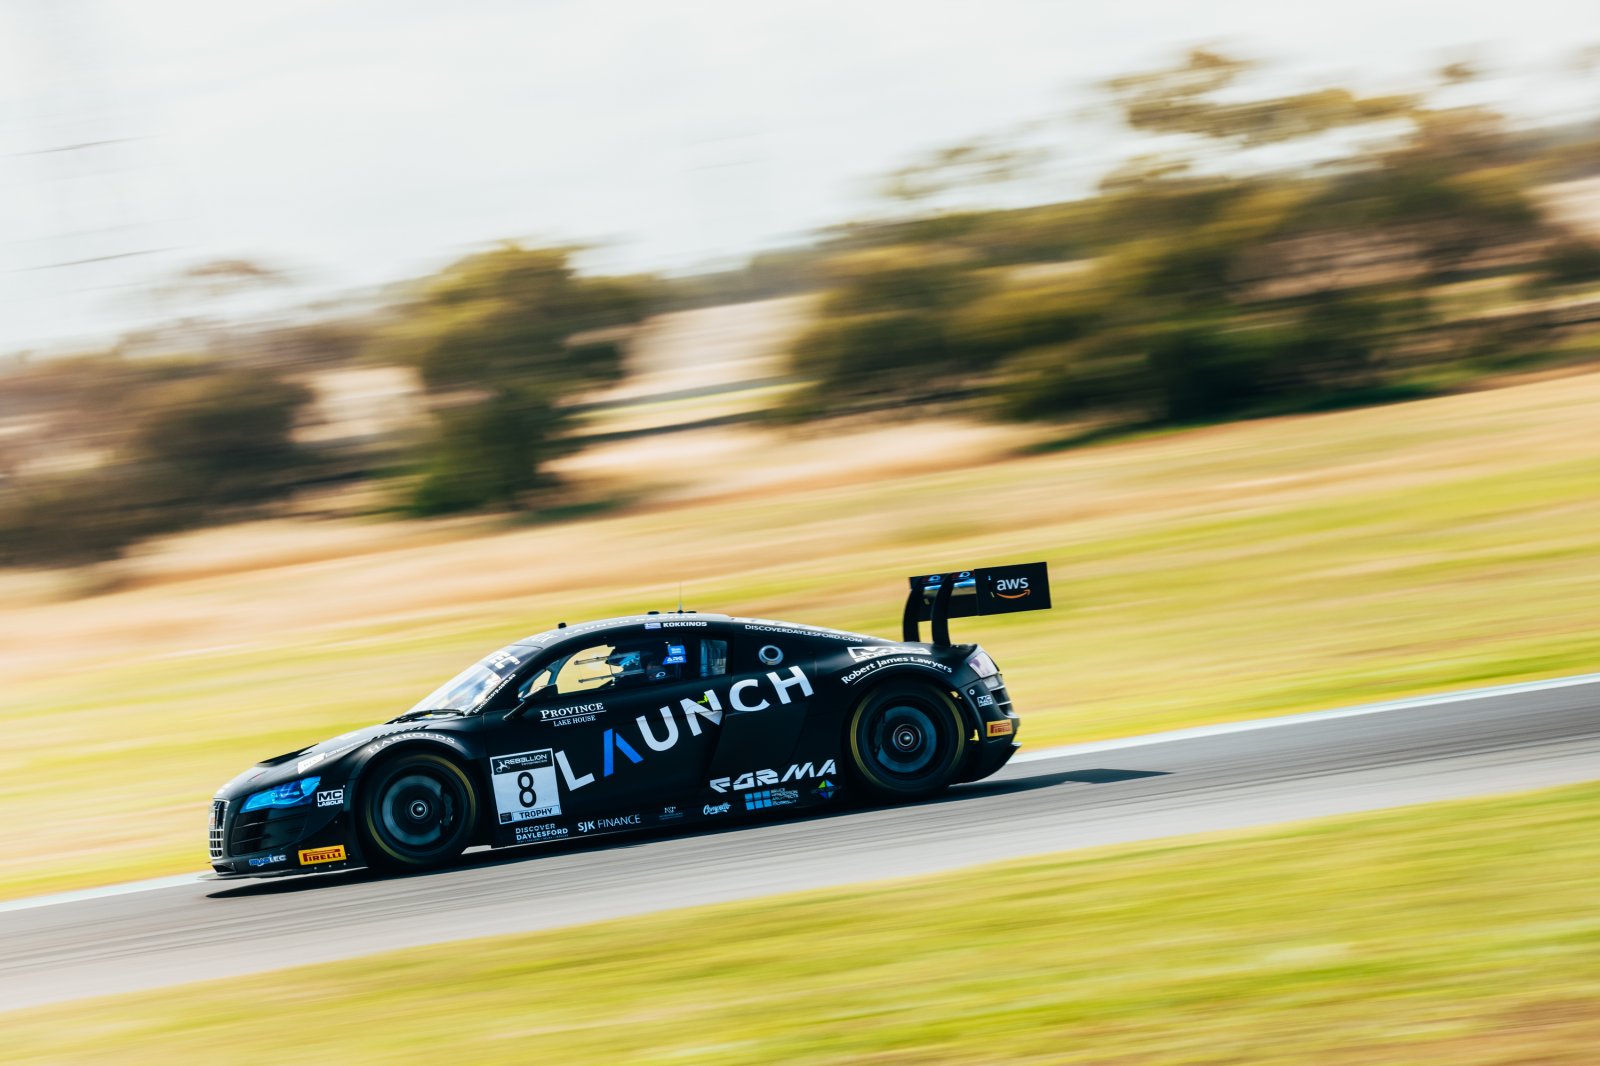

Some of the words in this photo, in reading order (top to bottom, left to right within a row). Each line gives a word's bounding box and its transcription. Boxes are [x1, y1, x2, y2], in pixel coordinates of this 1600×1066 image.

[996, 577, 1029, 591] aws
[744, 624, 863, 643] DISCOVERDAYLESFORD.COM
[840, 663, 876, 684] Robert
[876, 656, 909, 667] James
[910, 656, 953, 673] Lawyers
[540, 702, 604, 719] PROVINCE
[553, 717, 571, 727] LAKE
[572, 714, 596, 725] HOUSE
[554, 665, 815, 792] LAUNCH
[367, 732, 455, 754] HARROLDS
[319, 791, 343, 801] MC
[517, 771, 537, 808] 8
[519, 808, 552, 819] TROPHY
[515, 823, 556, 834] DISCOVER
[577, 821, 596, 833] SJK
[597, 814, 641, 829] FINANCE
[516, 828, 568, 841] DAYLESFORD
[302, 848, 341, 862] PIRELLI
